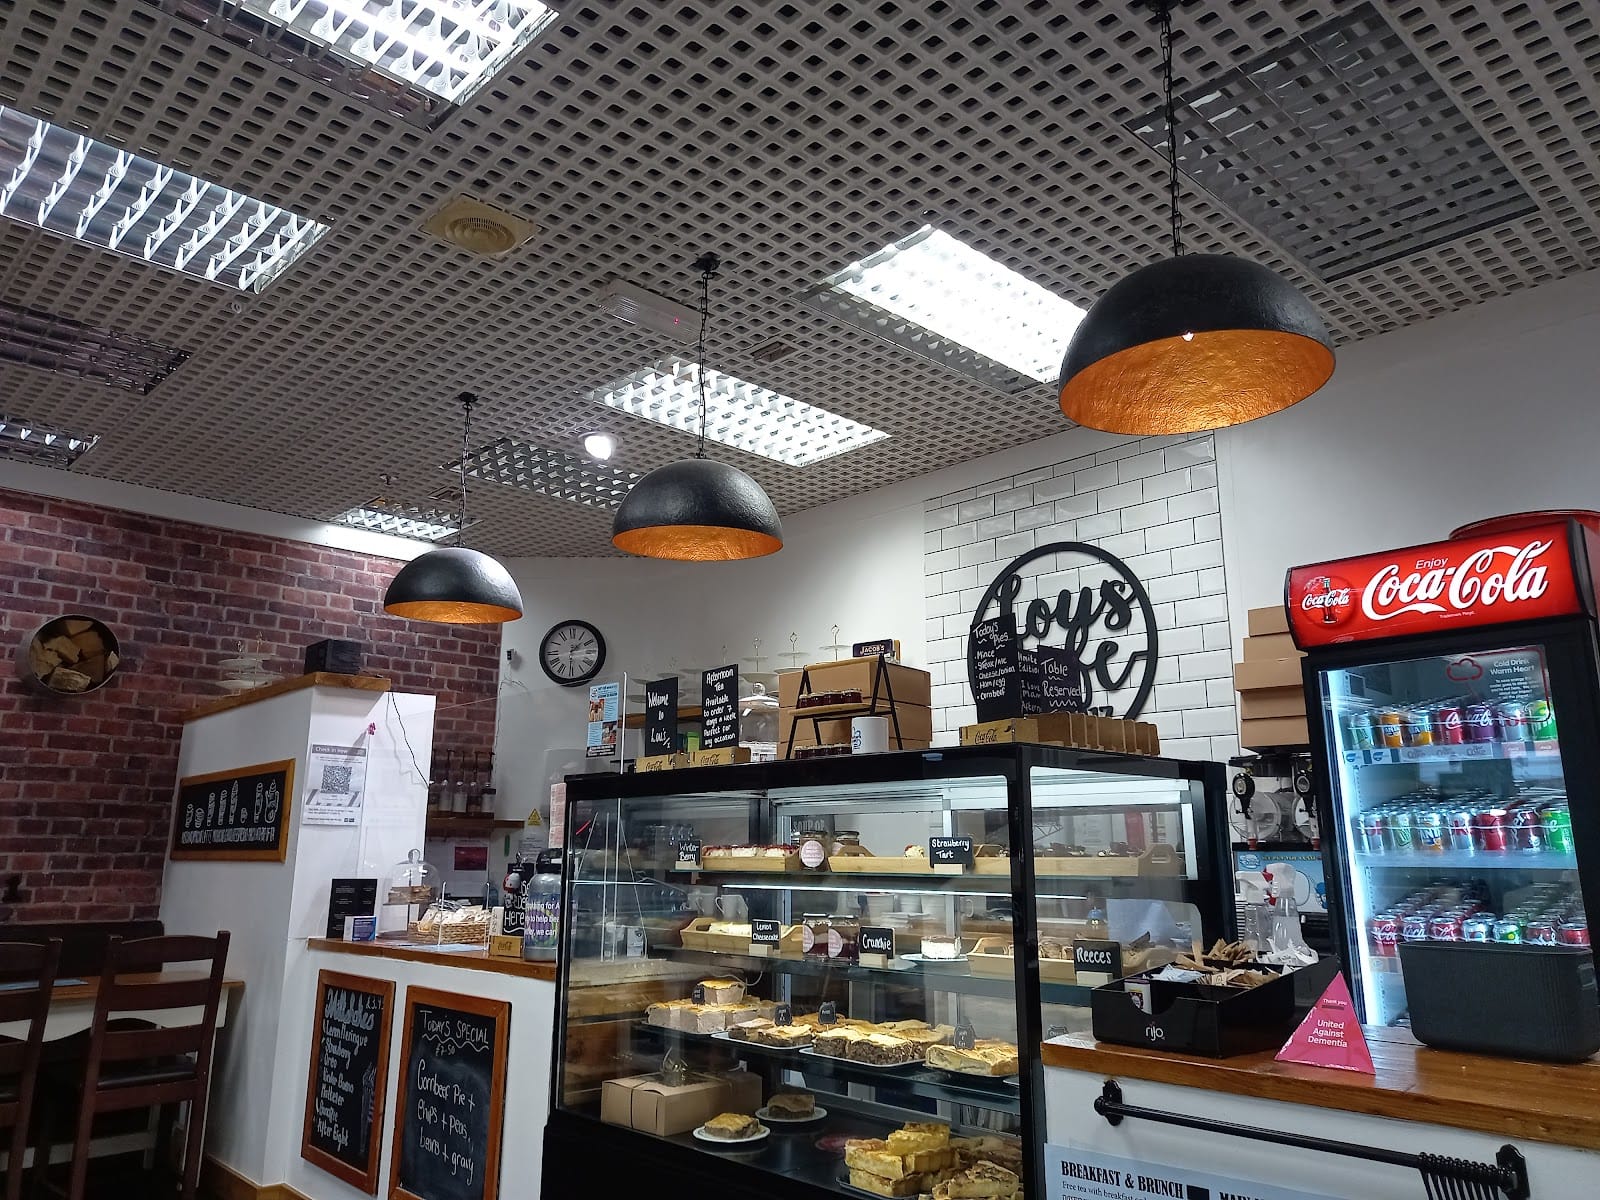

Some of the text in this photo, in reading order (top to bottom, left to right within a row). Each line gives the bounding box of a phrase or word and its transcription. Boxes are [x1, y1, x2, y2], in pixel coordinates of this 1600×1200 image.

[1415, 558, 1448, 570] Enjoy
[1362, 540, 1553, 620] Coca-Cola
[1302, 588, 1350, 610] Coca-Cola
[973, 621, 999, 638] Today's
[976, 650, 996, 660] Mince
[1040, 658, 1068, 677] Table
[1493, 660, 1510, 668] Cold
[1513, 665, 1535, 673] Heart
[706, 668, 734, 687] Afternoon
[714, 682, 725, 691] Tea
[1042, 680, 1081, 697] Reserved
[648, 691, 669, 708] Welcome
[705, 693, 729, 707] Available
[703, 704, 732, 717] to order 7
[706, 718, 718, 728] days
[723, 712, 737, 722] week
[704, 726, 720, 737] Perfect
[713, 733, 736, 744] occasion
[679, 842, 699, 852] Winter
[931, 838, 970, 852] Strawberry
[679, 851, 696, 862] Berry
[936, 850, 954, 859] Tart
[504, 910, 525, 927] Here
[752, 933, 779, 941] Cheesecake
[862, 934, 892, 951] Crunchie
[1076, 946, 1112, 965] Reeces
[1317, 1019, 1345, 1029] United
[456, 1020, 489, 1045] SPECIAL
[1313, 1028, 1345, 1038] Against
[1307, 1035, 1348, 1048] Dementia
[452, 1083, 466, 1106] Pie
[417, 1098, 438, 1125] Chips
[419, 1126, 440, 1156] beans
[451, 1151, 474, 1186] gravy
[1061, 1160, 1184, 1199] BREAKFAST & BRUNCH
[1062, 1181, 1077, 1191] Free
[1077, 1184, 1087, 1193] tea
[1088, 1186, 1102, 1197] with
